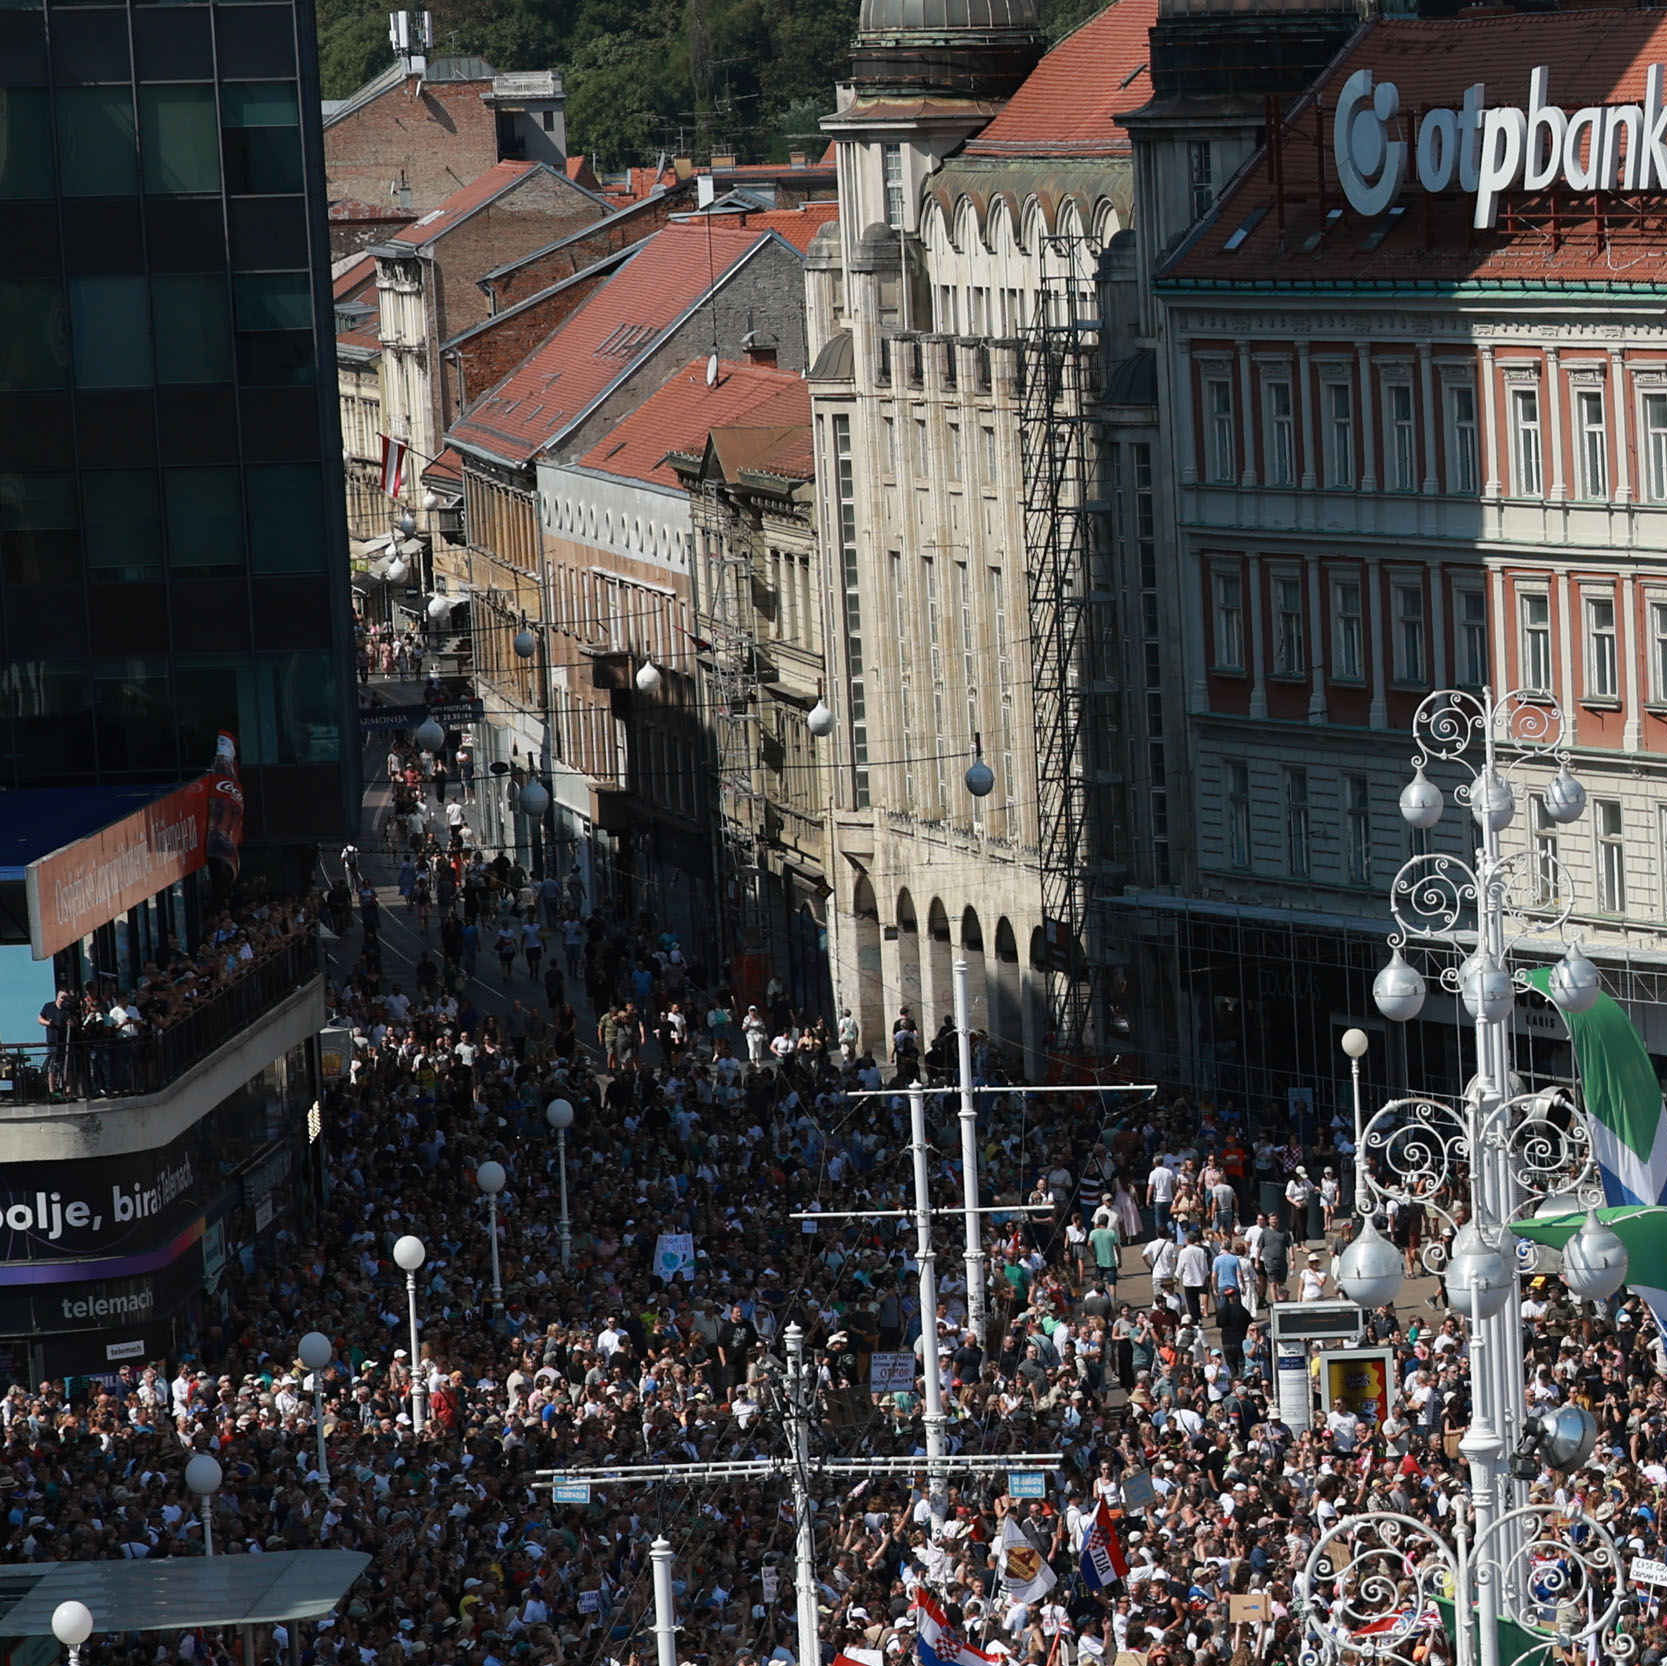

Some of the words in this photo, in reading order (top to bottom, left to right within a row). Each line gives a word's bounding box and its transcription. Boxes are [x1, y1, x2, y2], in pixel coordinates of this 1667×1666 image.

[0, 1192, 103, 1240] olje,
[62, 1287, 154, 1319] telemach
[110, 1343, 142, 1356] telemach
